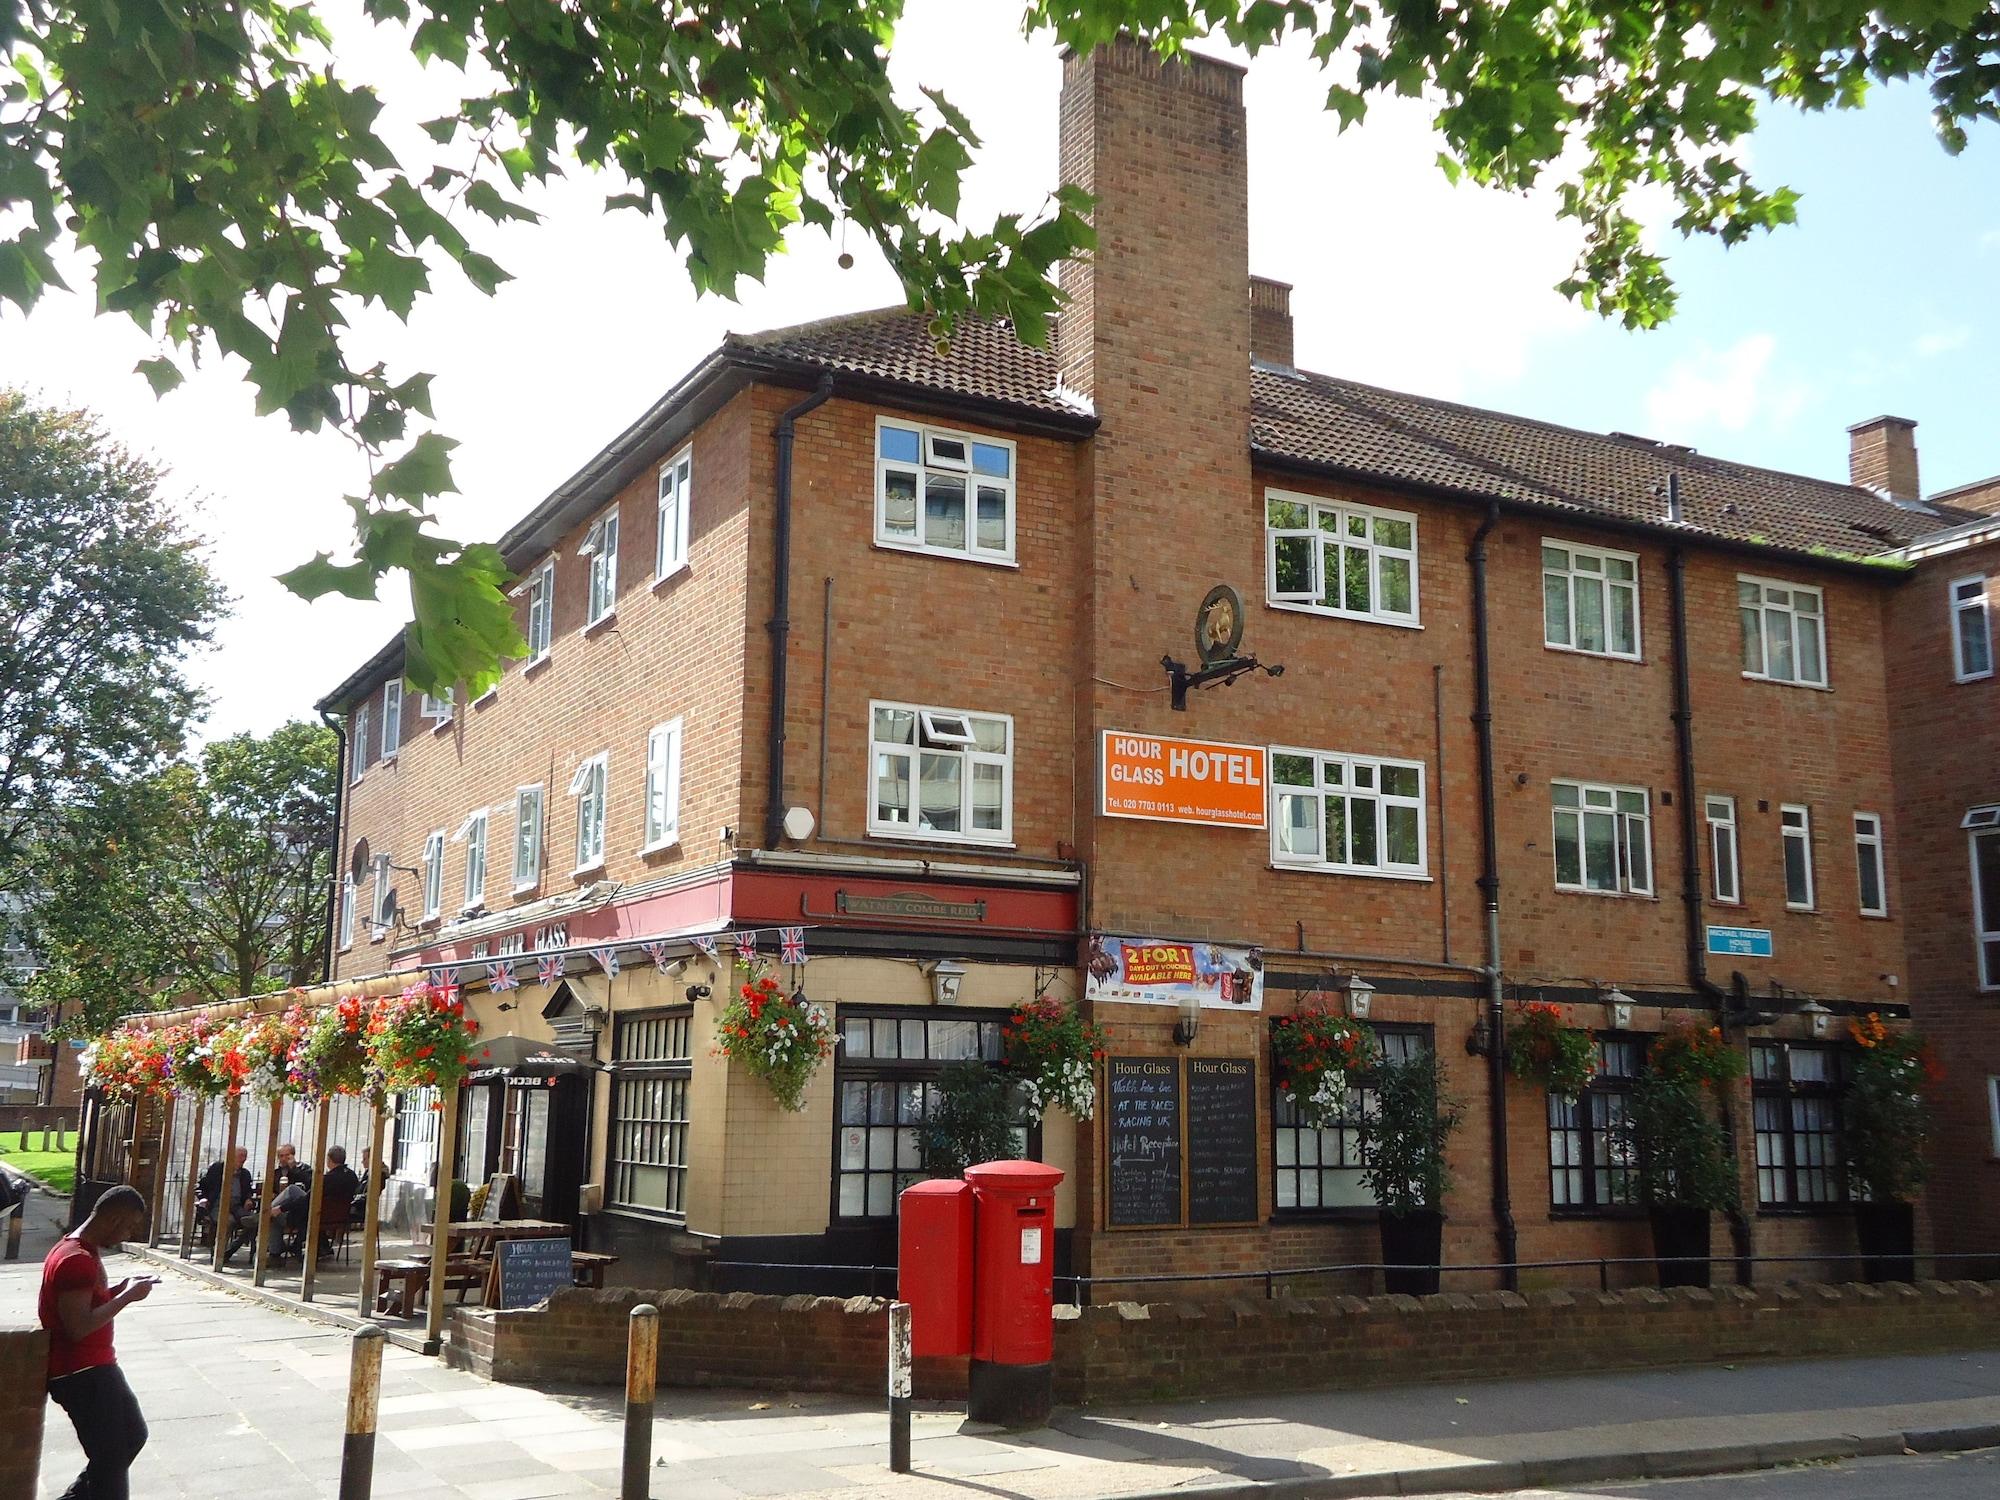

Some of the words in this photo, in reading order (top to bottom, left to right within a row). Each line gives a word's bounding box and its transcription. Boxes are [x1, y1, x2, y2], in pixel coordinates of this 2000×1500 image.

[1115, 738, 1161, 760] HOUR
[1169, 748, 1260, 786] HOTEL
[1111, 764, 1164, 786] GLASS
[1108, 798, 1122, 808] Tel.
[1123, 799, 1136, 808] 020
[1138, 800, 1156, 811] 7703
[1157, 802, 1174, 812] 0113
[1196, 806, 1262, 820] hourglasshotel.com
[905, 903, 946, 914] COMBE
[950, 906, 977, 916] REID
[471, 941, 489, 959] THE
[498, 932, 523, 956] HOUR
[1125, 948, 1139, 963] 2
[1142, 948, 1179, 963] FOR
[1181, 948, 1190, 962] 1
[1129, 972, 1173, 981] AVAILABLE
[1173, 971, 1192, 980] HERE
[525, 1056, 576, 1064] BECK'S
[468, 1066, 511, 1080] BECK'S
[1115, 1062, 1142, 1074] Hour
[1143, 1062, 1171, 1074] Glass
[1194, 1061, 1218, 1074] Hour
[1220, 1062, 1248, 1074] Glass
[1117, 1100, 1130, 1112] AT
[1134, 1100, 1148, 1111] THE
[1150, 1100, 1175, 1111] RACES
[1118, 1116, 1152, 1128] RACING
[1157, 1116, 1171, 1127] UK
[1112, 1134, 1137, 1153] Hotel
[1140, 1135, 1179, 1158] Reception
